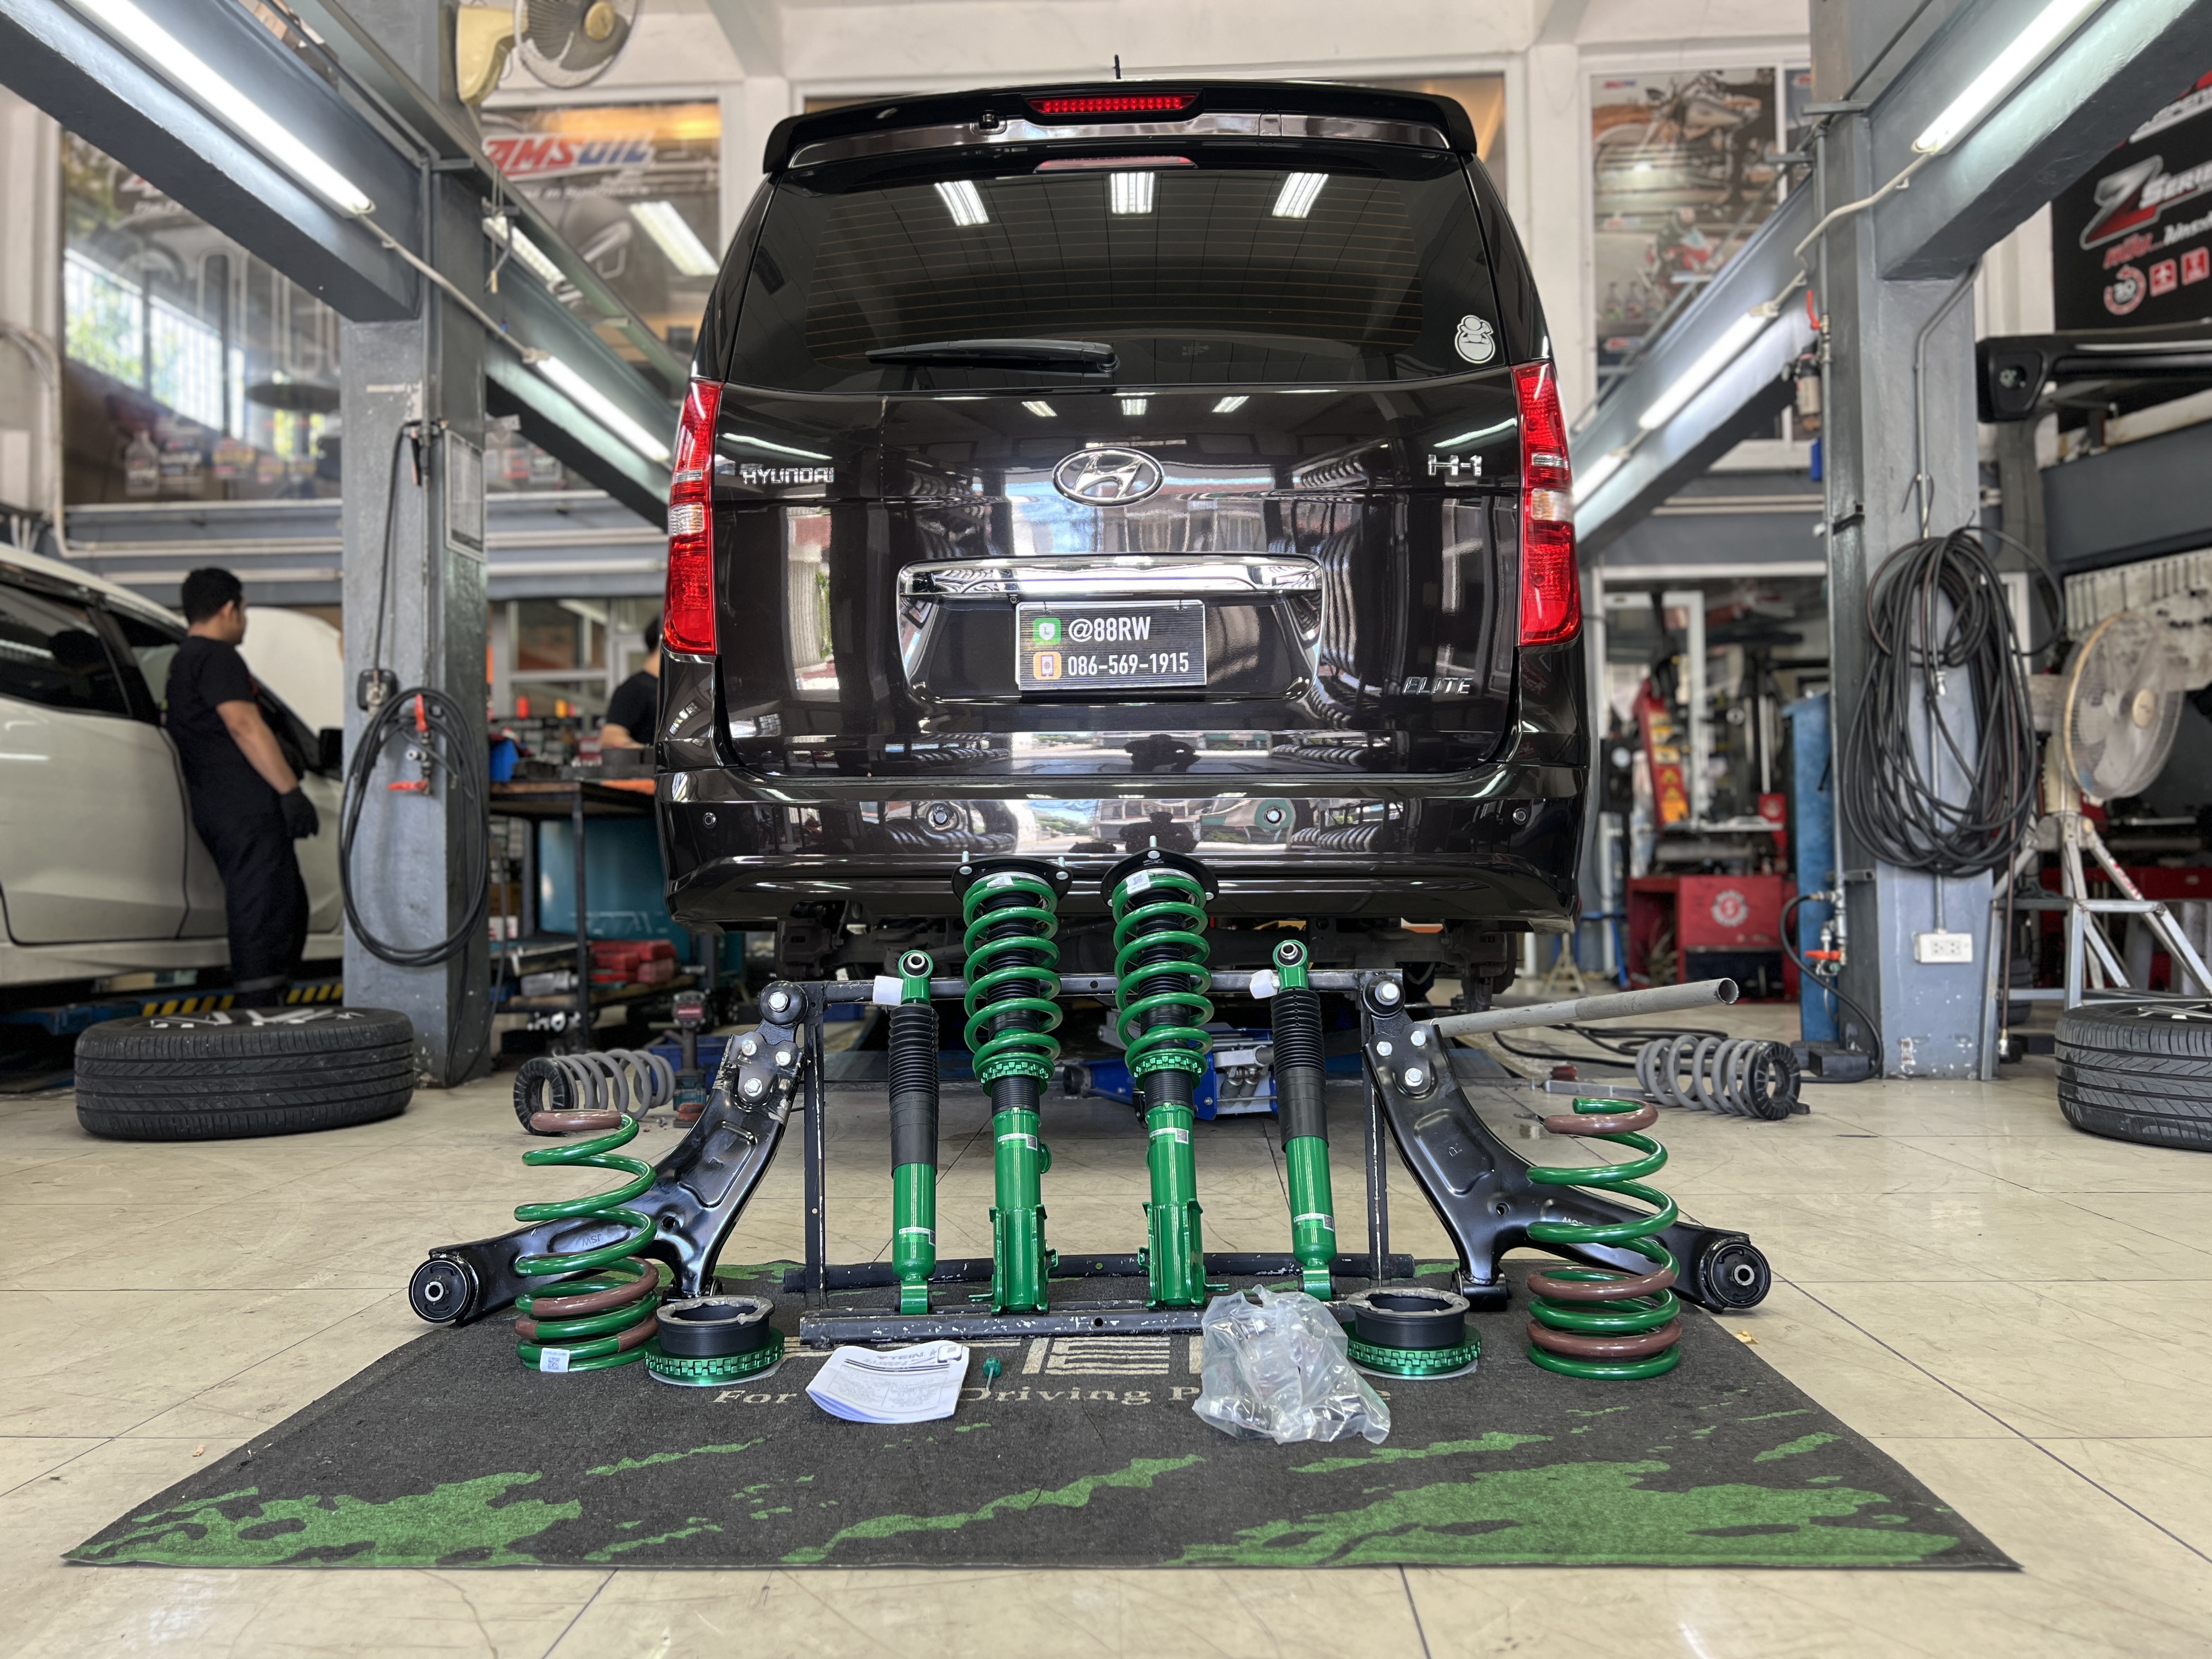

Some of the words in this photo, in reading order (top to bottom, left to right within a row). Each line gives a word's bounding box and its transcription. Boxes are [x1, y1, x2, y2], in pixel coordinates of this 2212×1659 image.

[1427, 454, 1482, 476] H-1
[742, 467, 834, 485] HYUNDAI
[1068, 616, 1150, 642] @88RW
[1068, 652, 1189, 676] 086-569-1915
[1402, 676, 1473, 695] ELITE
[712, 1390, 798, 1404] For
[958, 1386, 1152, 1406] Driving
